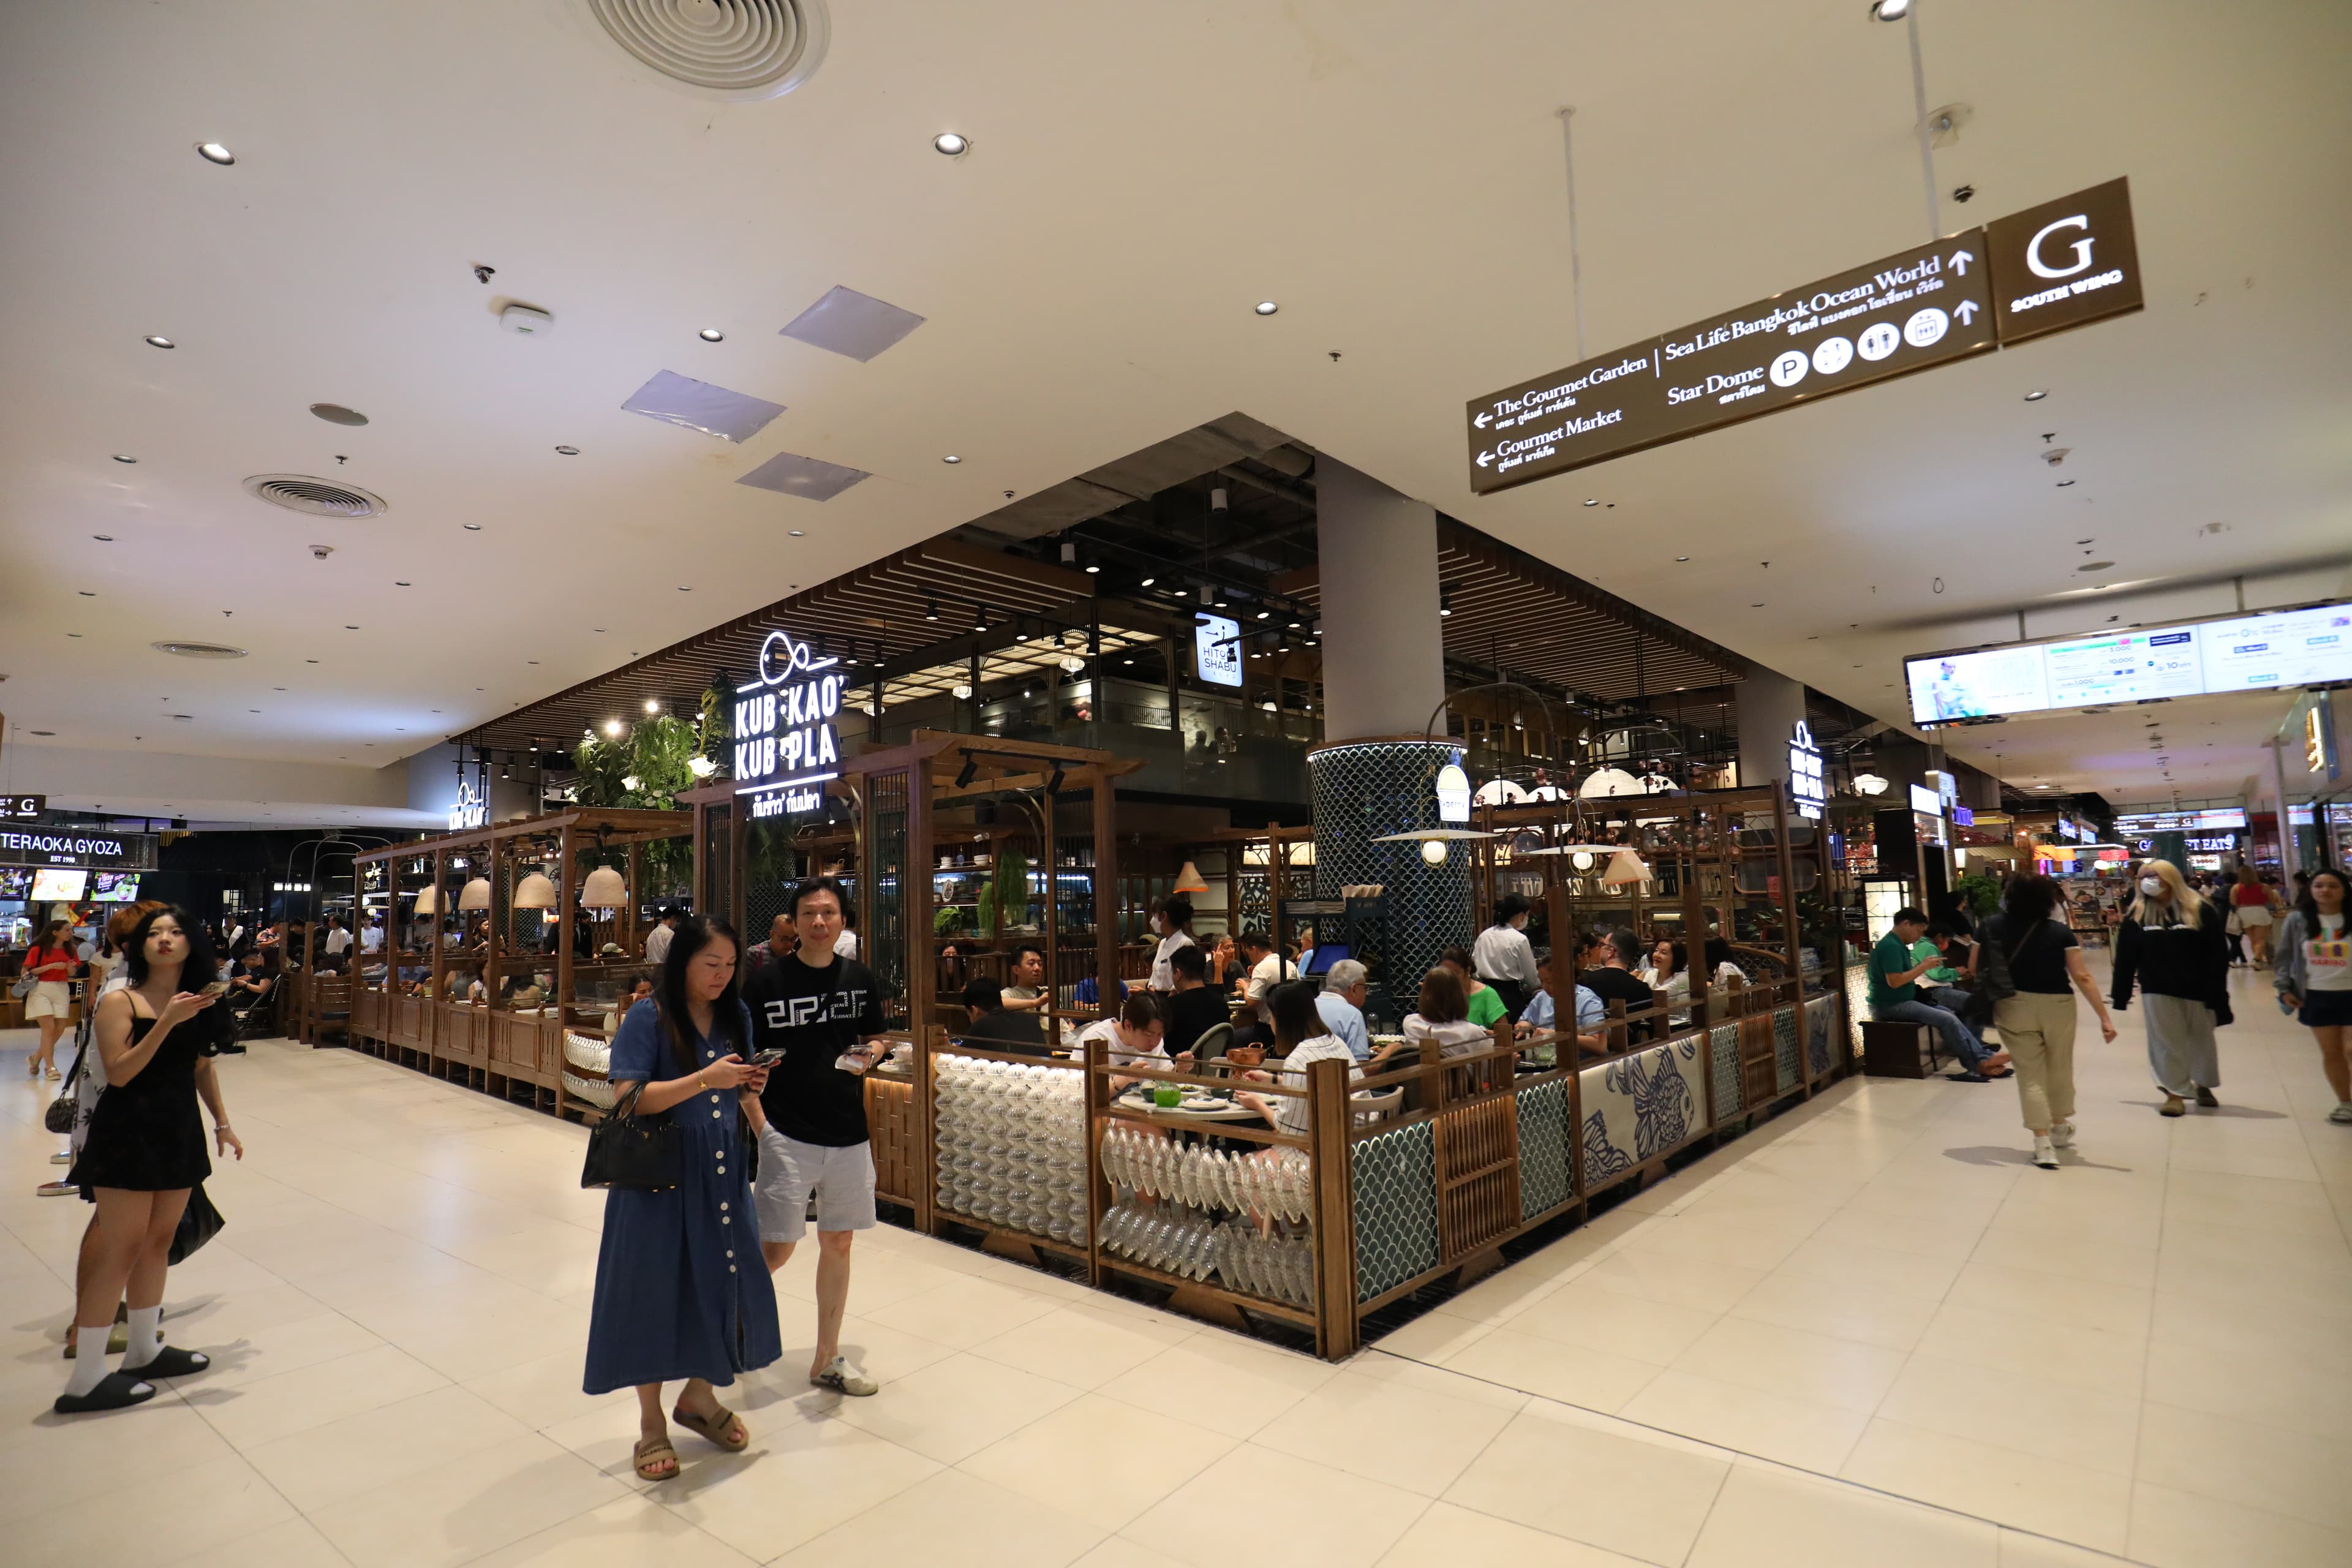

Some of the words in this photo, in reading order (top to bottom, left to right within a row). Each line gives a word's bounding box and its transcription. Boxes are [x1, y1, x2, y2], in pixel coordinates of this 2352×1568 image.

[2026, 214, 2095, 278] G
[1665, 343, 1695, 360] Sea
[1695, 328, 1731, 351] Life
[1731, 301, 1811, 339] Bangkok
[1810, 283, 1875, 311] Ocean
[1874, 255, 1942, 290] World
[2011, 285, 2070, 313] SOUTH
[2069, 270, 2123, 294] WING
[1494, 400, 1522, 417] The
[1523, 377, 1589, 407] Gourmet
[1589, 358, 1648, 385] Garden
[1668, 385, 1704, 405] Star
[1706, 367, 1764, 394] Dome
[1497, 426, 1563, 457] Gourmet
[1566, 409, 1623, 437] Market
[1204, 646, 1232, 659] HITO
[1205, 658, 1237, 673] SHABU
[736, 694, 776, 739] KUB
[735, 737, 776, 780] KUB
[788, 723, 837, 770] PLA
[21, 799, 34, 812] G
[0, 833, 73, 853] TERAOKA
[76, 839, 122, 856] GYOZA
[2203, 837, 2234, 850] EATS
